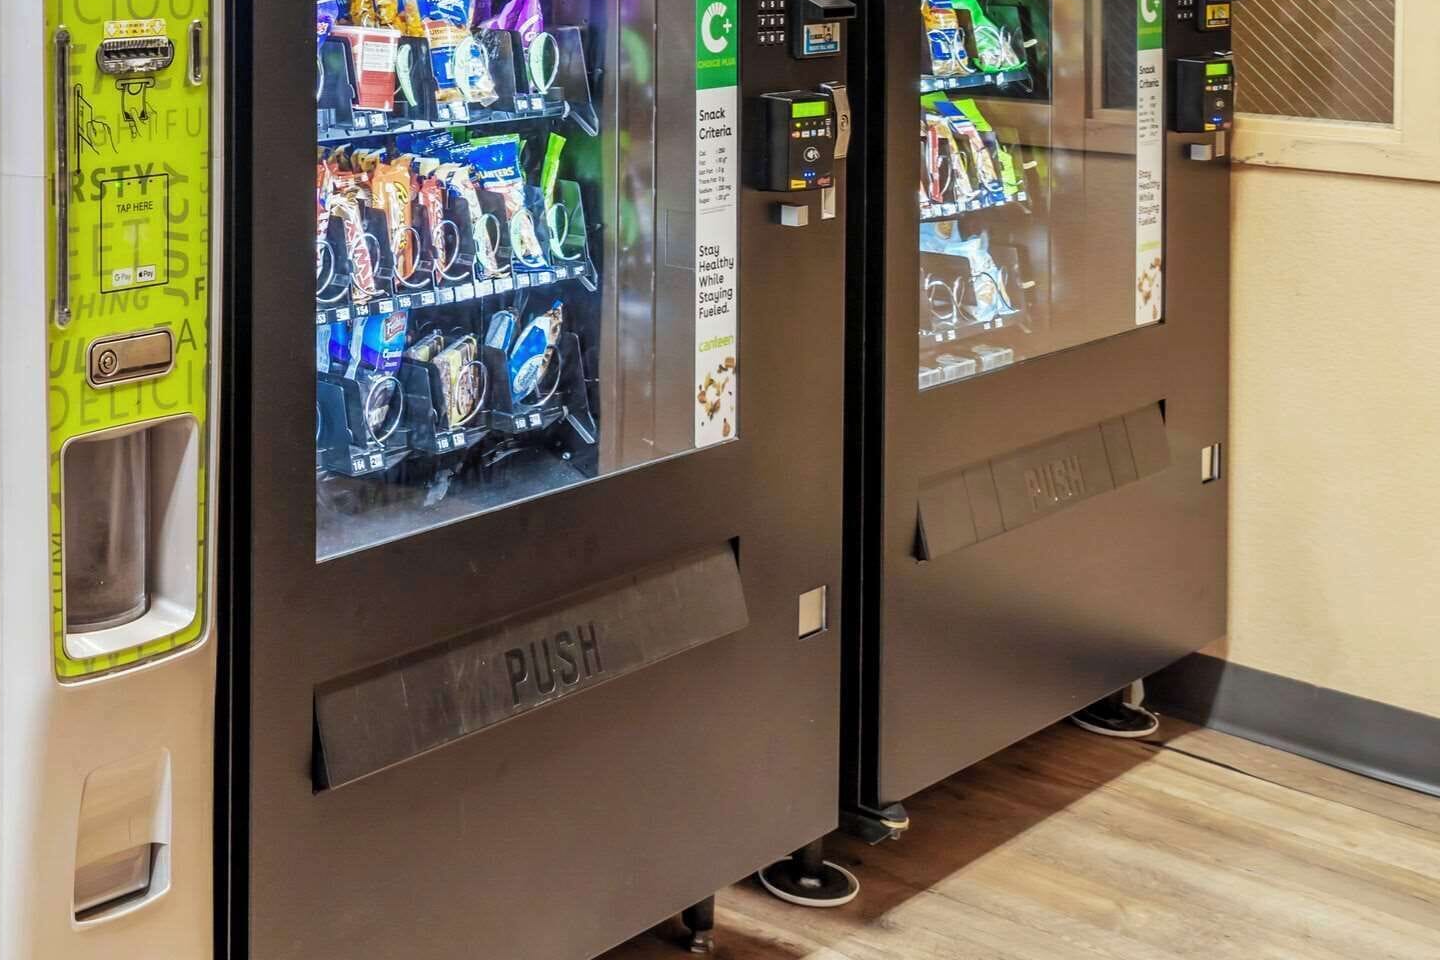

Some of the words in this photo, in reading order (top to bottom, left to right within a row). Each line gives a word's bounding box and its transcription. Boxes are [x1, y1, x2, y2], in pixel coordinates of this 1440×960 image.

[698, 107, 726, 122] Snack
[698, 124, 732, 140] Criteria
[117, 202, 132, 214] TAP
[133, 200, 153, 213] HERE
[698, 244, 720, 258] Stay
[698, 256, 735, 273] Healthy
[143, 269, 154, 280] Pay
[698, 273, 724, 288] While
[698, 287, 734, 304] Staying
[698, 303, 730, 320] Fueled.
[698, 335, 735, 353] canteen
[1023, 455, 1087, 513] PUSH
[505, 620, 606, 708] PUSH
